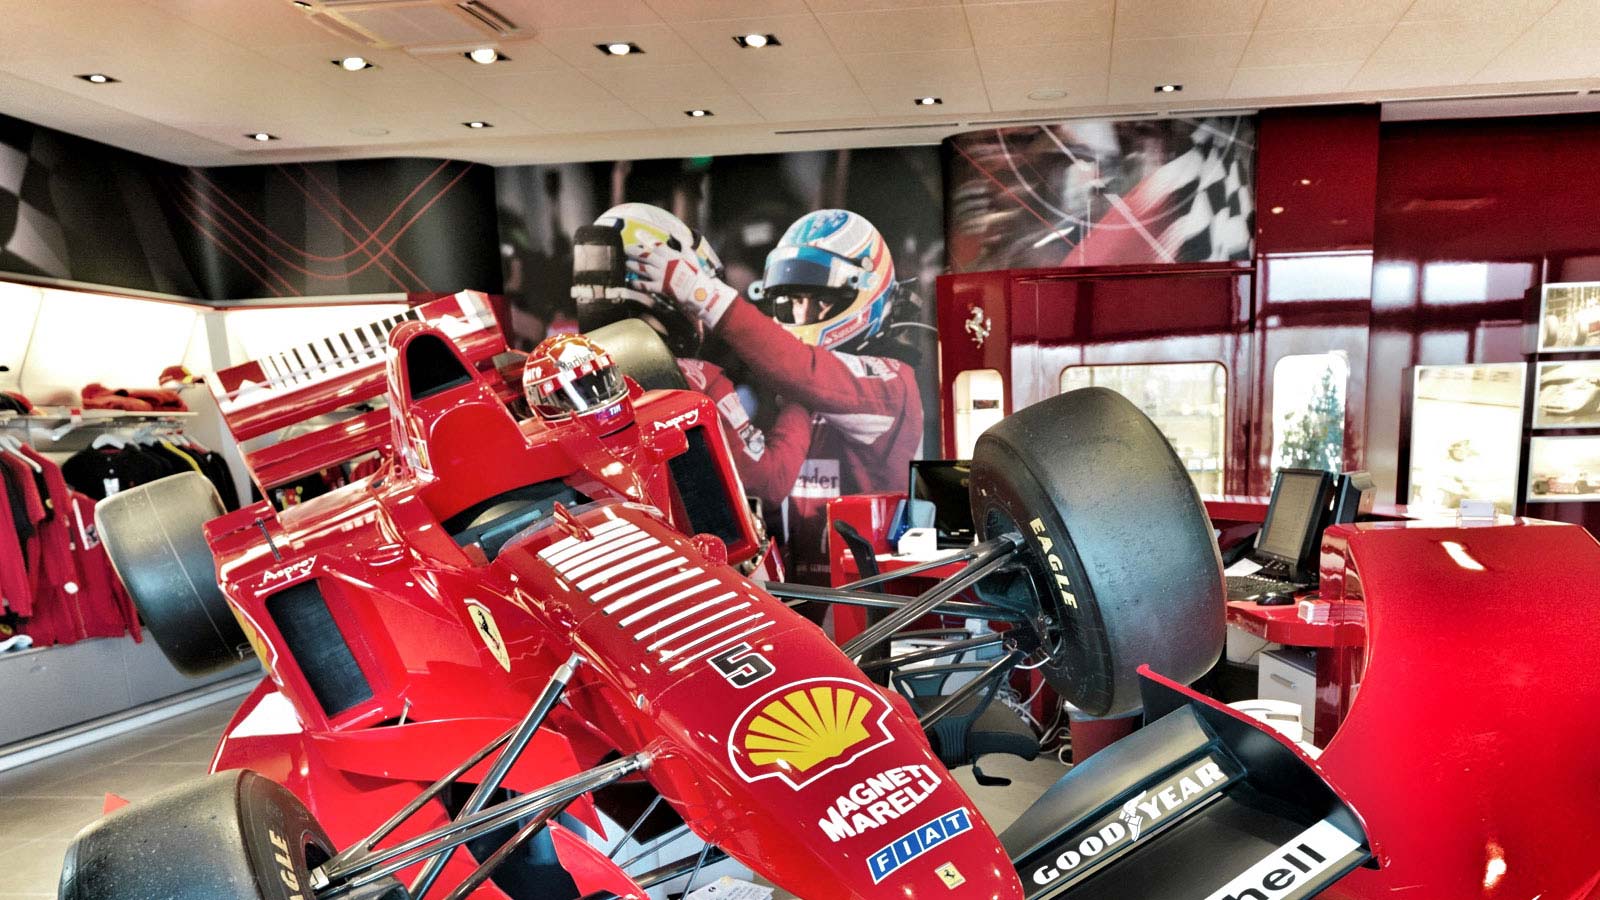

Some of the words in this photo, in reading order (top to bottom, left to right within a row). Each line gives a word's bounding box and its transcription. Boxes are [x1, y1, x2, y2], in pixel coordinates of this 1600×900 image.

[1029, 517, 1078, 609] EAGLE
[706, 641, 776, 689] 5
[818, 764, 939, 839] MAGNETI
[818, 770, 942, 842] MARELLI
[876, 813, 961, 873] FIAT
